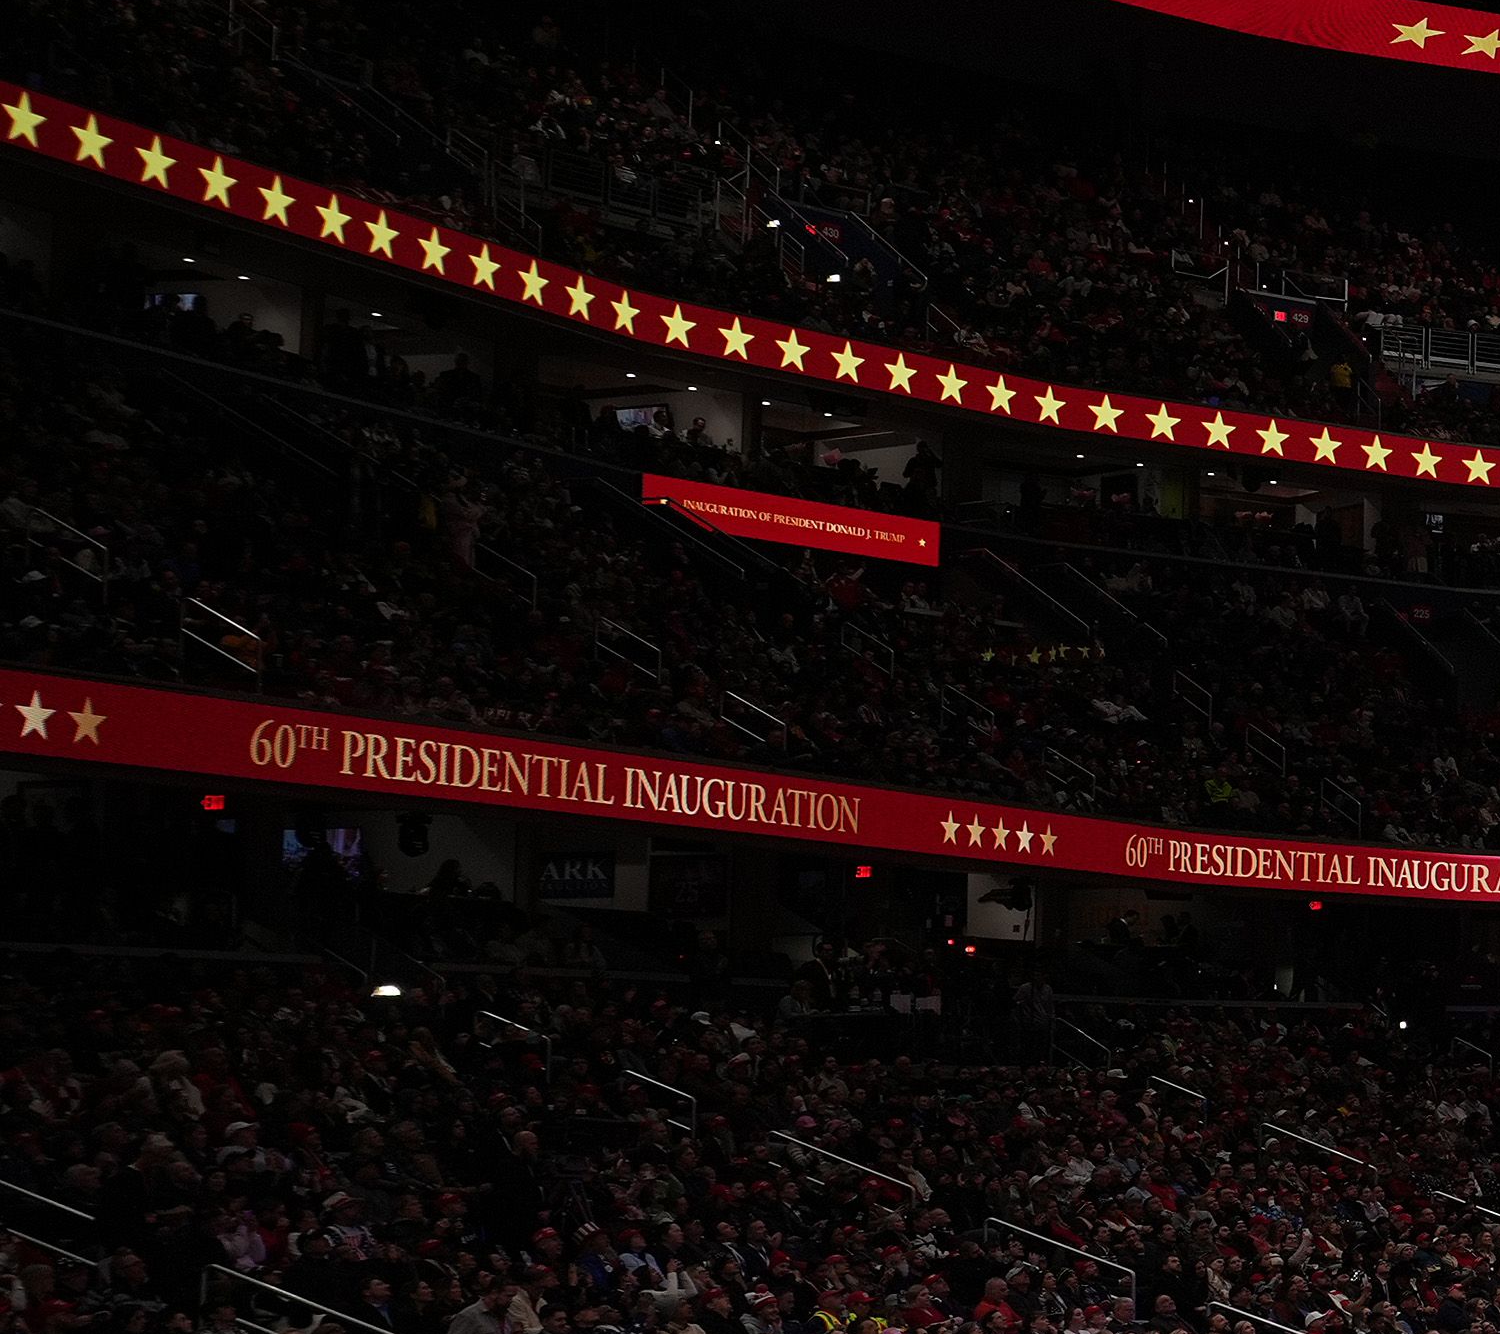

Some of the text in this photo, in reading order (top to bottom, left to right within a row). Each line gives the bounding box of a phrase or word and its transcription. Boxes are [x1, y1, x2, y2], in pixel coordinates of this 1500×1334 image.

[683, 498, 758, 520] INAUGURATION
[759, 511, 772, 522] OF
[773, 513, 825, 530] PRESIDENT
[826, 522, 865, 537] DONALD
[874, 530, 906, 543] TRUMP
[249, 719, 861, 835] 60TH PRESIDENTIAL INAUGURATION
[545, 859, 611, 880] ARK
[1125, 833, 1164, 867] 60TH
[1168, 840, 1361, 885] PRESIDENTIAL
